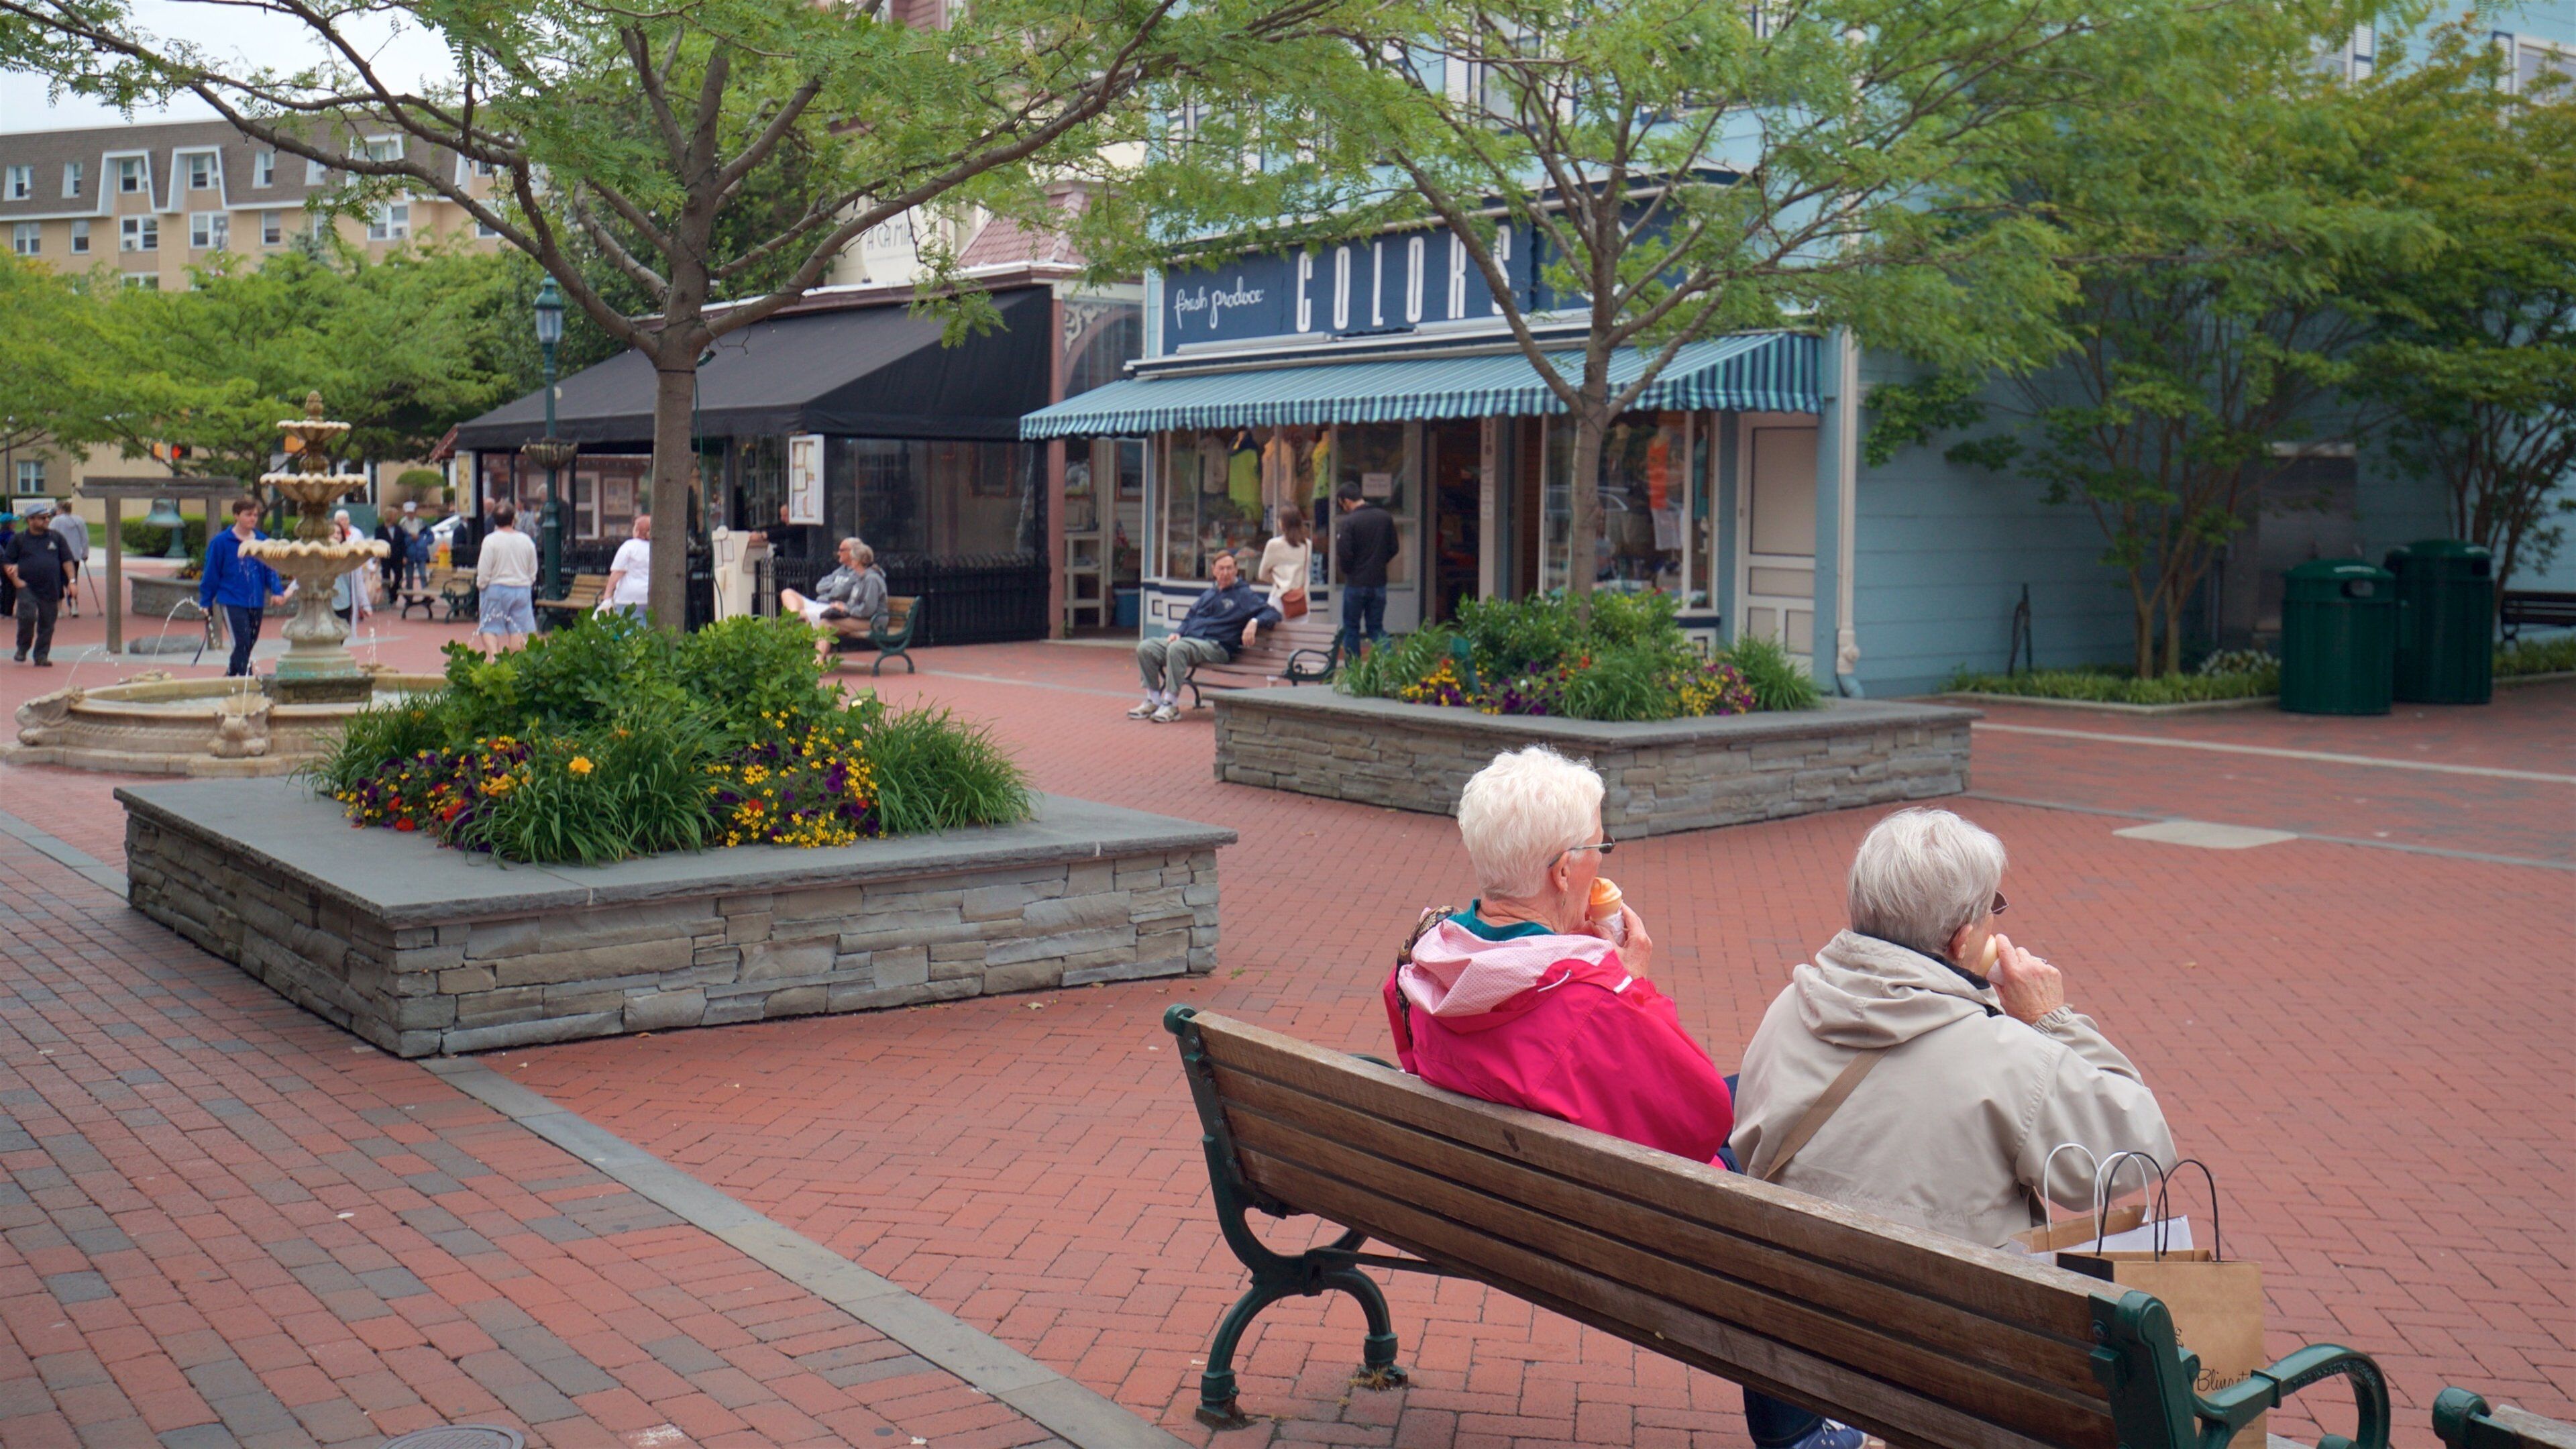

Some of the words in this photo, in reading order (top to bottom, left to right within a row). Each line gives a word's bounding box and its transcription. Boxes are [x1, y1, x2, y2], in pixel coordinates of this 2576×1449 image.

[1174, 288, 1208, 330] fresh
[1209, 276, 1263, 329] produce
[1296, 224, 1511, 333] COLORS
